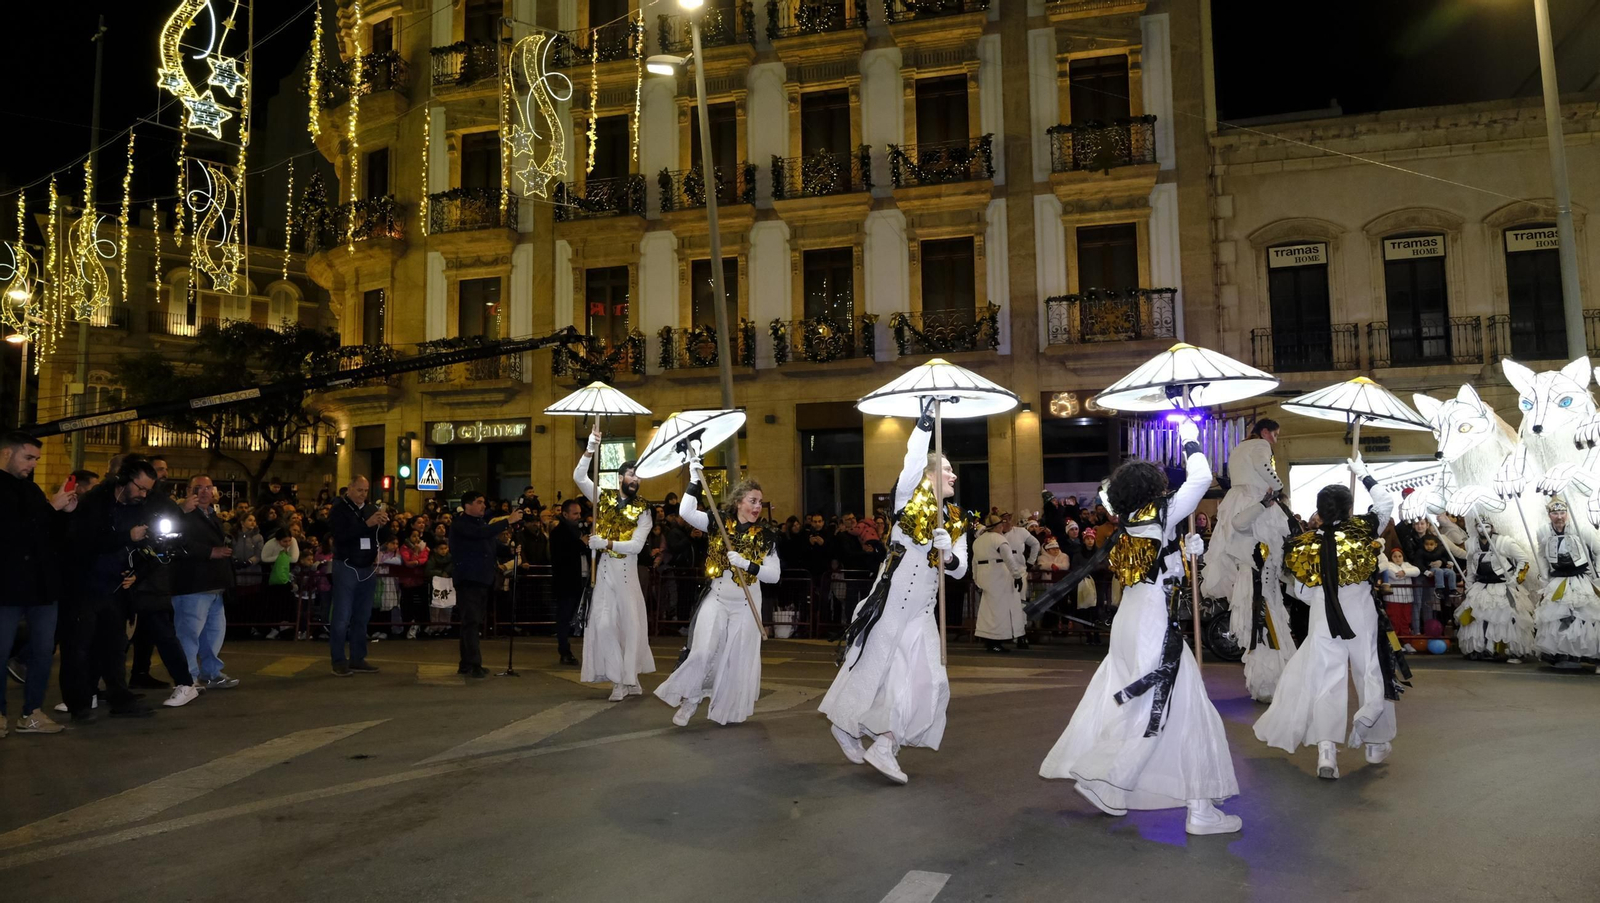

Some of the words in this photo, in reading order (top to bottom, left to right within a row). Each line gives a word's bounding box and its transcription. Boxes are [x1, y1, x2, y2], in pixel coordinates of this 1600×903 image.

[1390, 238, 1438, 249] Tramas
[1273, 246, 1319, 257] Tramas
[1412, 248, 1438, 256] HOME
[1294, 255, 1320, 263] HOME
[457, 421, 527, 443] cajamar
